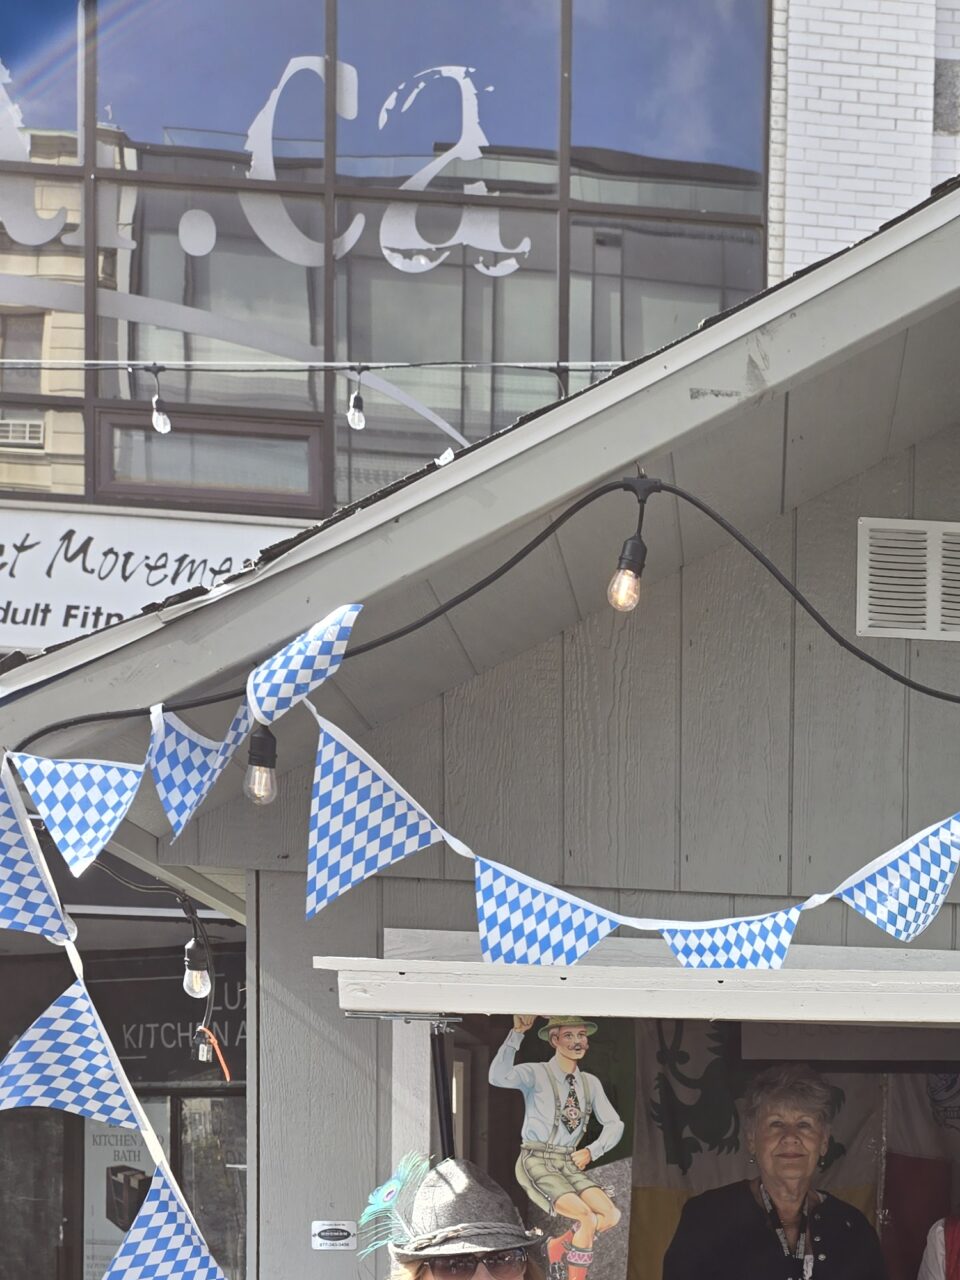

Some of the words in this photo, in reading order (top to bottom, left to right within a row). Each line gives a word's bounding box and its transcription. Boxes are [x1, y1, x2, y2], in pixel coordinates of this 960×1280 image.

[46, 529, 236, 587] Moveme
[122, 1021, 229, 1049] KITCHN
[113, 1150, 141, 1162] BATH
